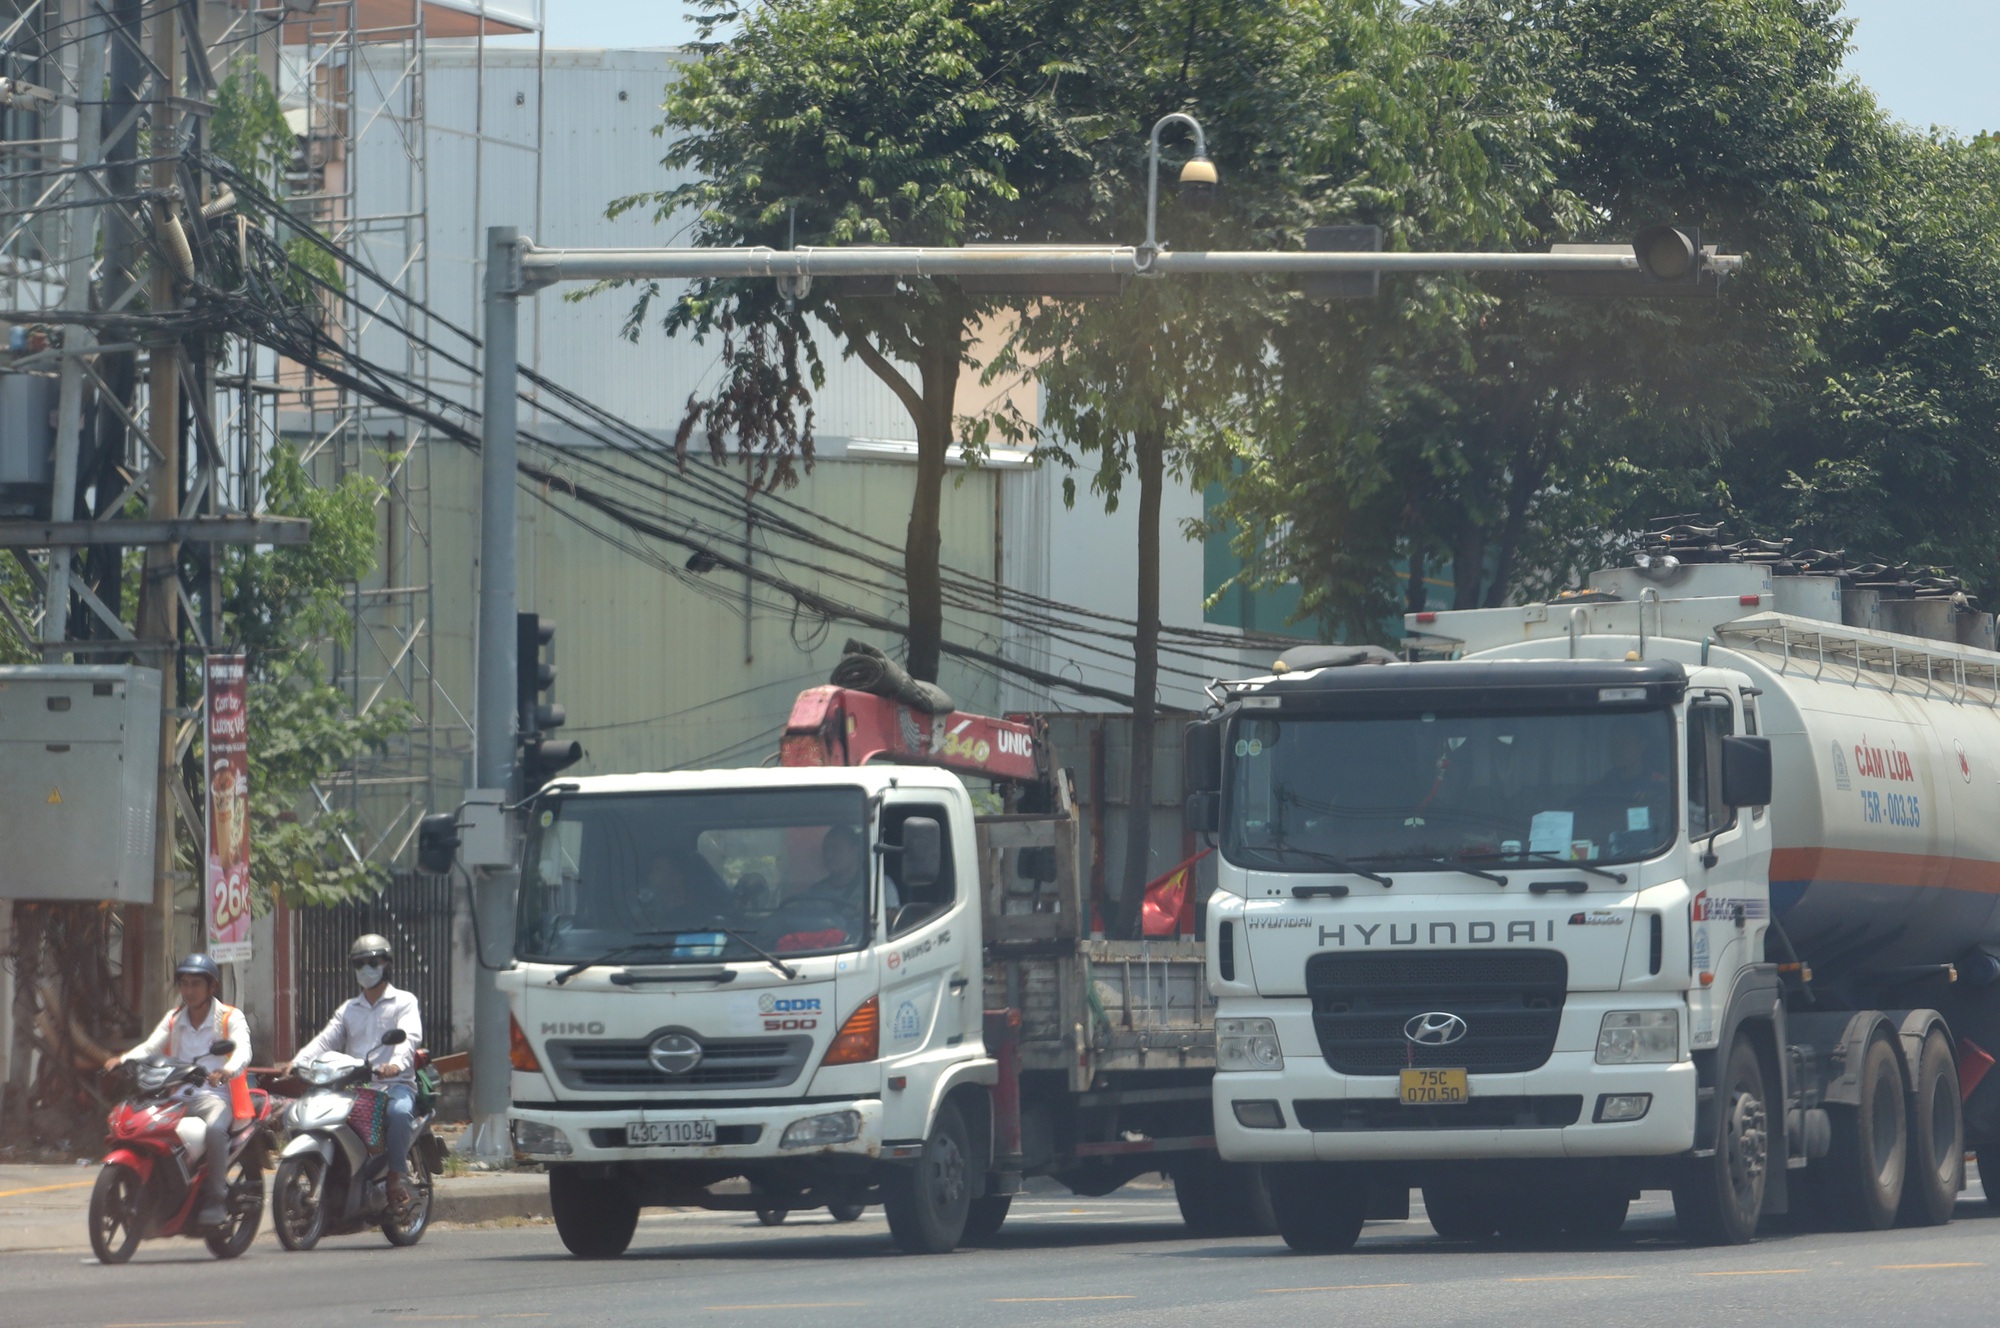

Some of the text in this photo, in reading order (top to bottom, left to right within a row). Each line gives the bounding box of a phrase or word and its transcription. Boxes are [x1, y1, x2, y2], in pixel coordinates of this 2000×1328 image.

[998, 729, 1032, 757] UNIC
[1861, 789, 1882, 823] 75R
[1887, 792, 1920, 828] 003.35
[1249, 916, 1312, 929] HYUNDAI
[1318, 920, 1554, 946] HYUNDAI
[775, 998, 821, 1012] QDR
[541, 1021, 606, 1035] HINO
[764, 1019, 817, 1031] 500
[1419, 1071, 1447, 1085] 75C
[1408, 1087, 1460, 1102] 070.50
[631, 1122, 712, 1142] 43C-110.94
